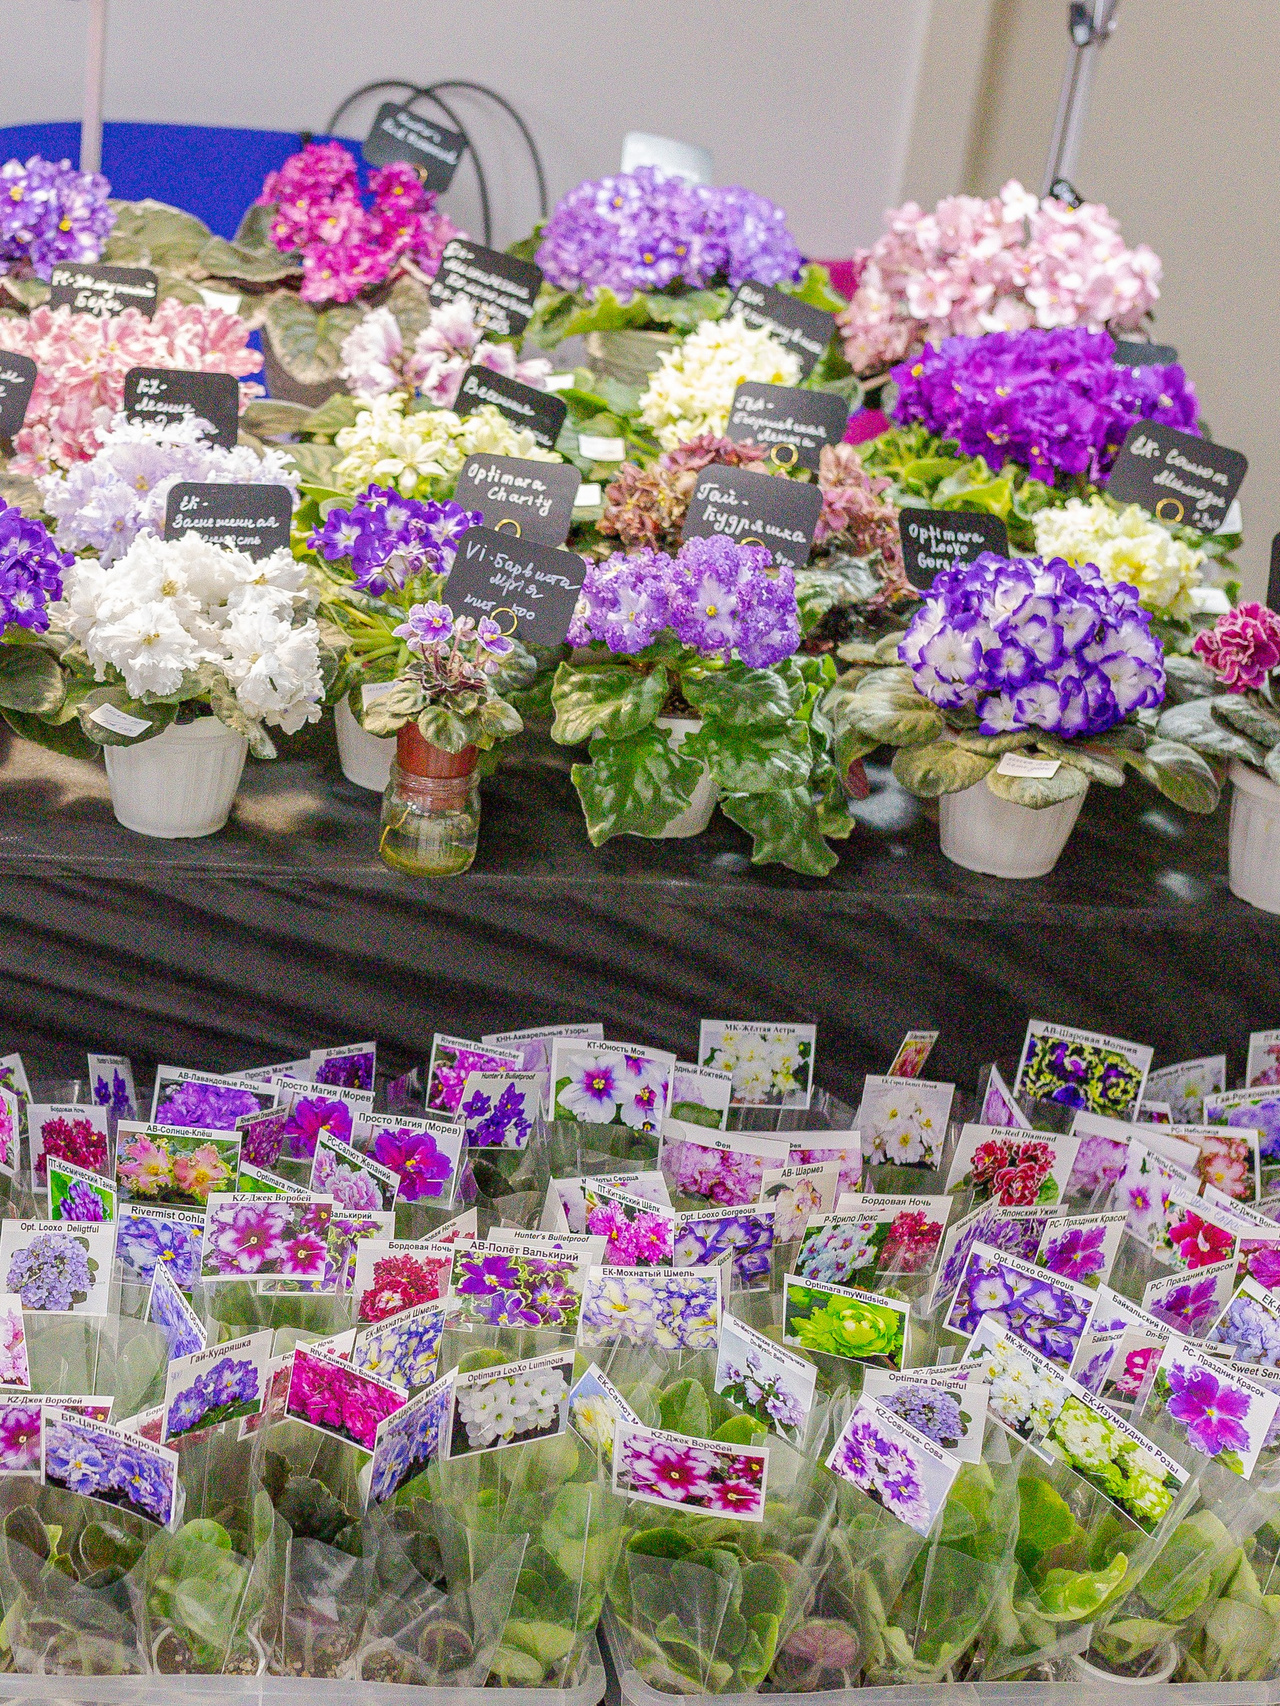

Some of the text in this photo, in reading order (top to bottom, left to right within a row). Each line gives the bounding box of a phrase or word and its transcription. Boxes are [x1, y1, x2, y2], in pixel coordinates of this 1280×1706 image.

[466, 463, 547, 493] Optimara
[485, 484, 553, 517] Charity
[773, 1026, 796, 1035] Астра
[587, 1042, 646, 1057] КТ-Юность Моя
[272, 1064, 294, 1075] Магия
[481, 1072, 536, 1081] Hunter's Bulletproof
[177, 1071, 260, 1092] АВ-Лавандовые Розы
[276, 1079, 375, 1105] Просто Магия (Морев)
[359, 1113, 462, 1138] Просто Магия (Морев)
[991, 1127, 1057, 1143] Dn-Red Diamond
[715, 1140, 731, 1150] Фея
[327, 1134, 391, 1181] РС-Салют Желаний
[796, 1165, 824, 1177] Шармез
[232, 1192, 312, 1203] KZ-Джек Воробей
[641, 1200, 661, 1213] Шёлк
[861, 1196, 931, 1207] Бордовая Ночь
[131, 1205, 175, 1221] Rivermist
[680, 1207, 757, 1222] Opt. Looxo Gorgeous
[857, 1212, 878, 1223] Люкс
[1062, 1217, 1099, 1227] Праздник
[1099, 1213, 1128, 1223] Красок
[20, 1223, 100, 1234] Opt. Looxo Deligtful
[514, 1230, 591, 1243] Hunter's Bulletproof
[388, 1241, 453, 1253] Бордовая Ночь
[469, 1241, 580, 1262] АВ-Полёт Валькирий
[601, 1266, 695, 1279] ЕК-Мохнатый Шмель
[993, 1252, 1075, 1292] Opt. Looxo Gorgeous
[1165, 1270, 1204, 1288] Праздник
[1206, 1262, 1234, 1275] Красок
[804, 1279, 889, 1308] Optimara myWildside
[1111, 1294, 1159, 1327] Байкальский
[365, 1303, 440, 1341] ЕК-Мохнатый Шмель
[189, 1340, 252, 1366] Гай-Кудряшка
[1003, 1332, 1065, 1382] МК-Жёлтая Астра
[309, 1347, 358, 1375] RIV-Каникулы
[357, 1366, 398, 1393] Бонифация
[467, 1356, 565, 1383] Optimara LooXo Luminous
[1197, 1354, 1235, 1382] Праздник
[1236, 1378, 1266, 1399] Красок
[887, 1373, 968, 1391] Optimara Deligtful
[7, 1396, 84, 1406] KZ-Джек Воробей
[596, 1373, 632, 1418] ЕК-Салют
[60, 1412, 161, 1455] БР-Царство Мороза
[650, 1430, 733, 1453] KZ-Джек Воробей
[1081, 1390, 1180, 1475] ЕК-Изумрудные Розы
[923, 1441, 945, 1461] Сова
